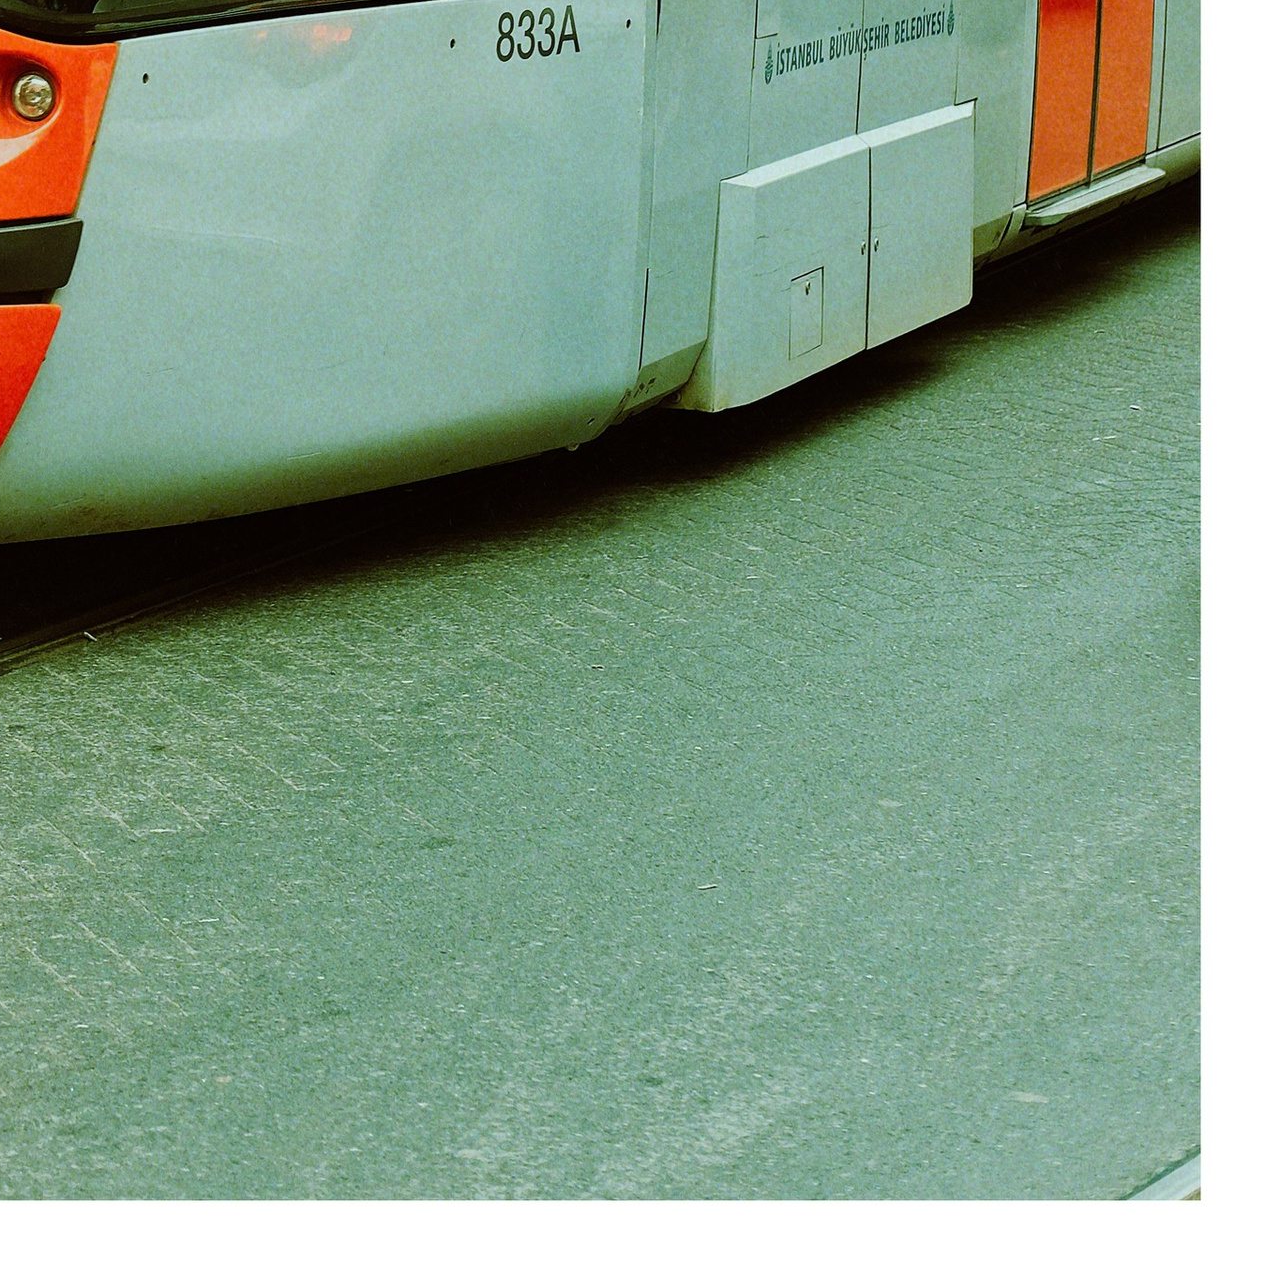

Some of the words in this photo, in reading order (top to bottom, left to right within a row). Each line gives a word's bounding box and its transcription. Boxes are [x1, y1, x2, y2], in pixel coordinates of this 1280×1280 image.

[496, 4, 581, 63] 833A
[776, 42, 825, 76] İSTANBUL
[829, 17, 890, 61] BÜYÜKŞEHİR
[894, 3, 946, 45] BELEDİYESİ
